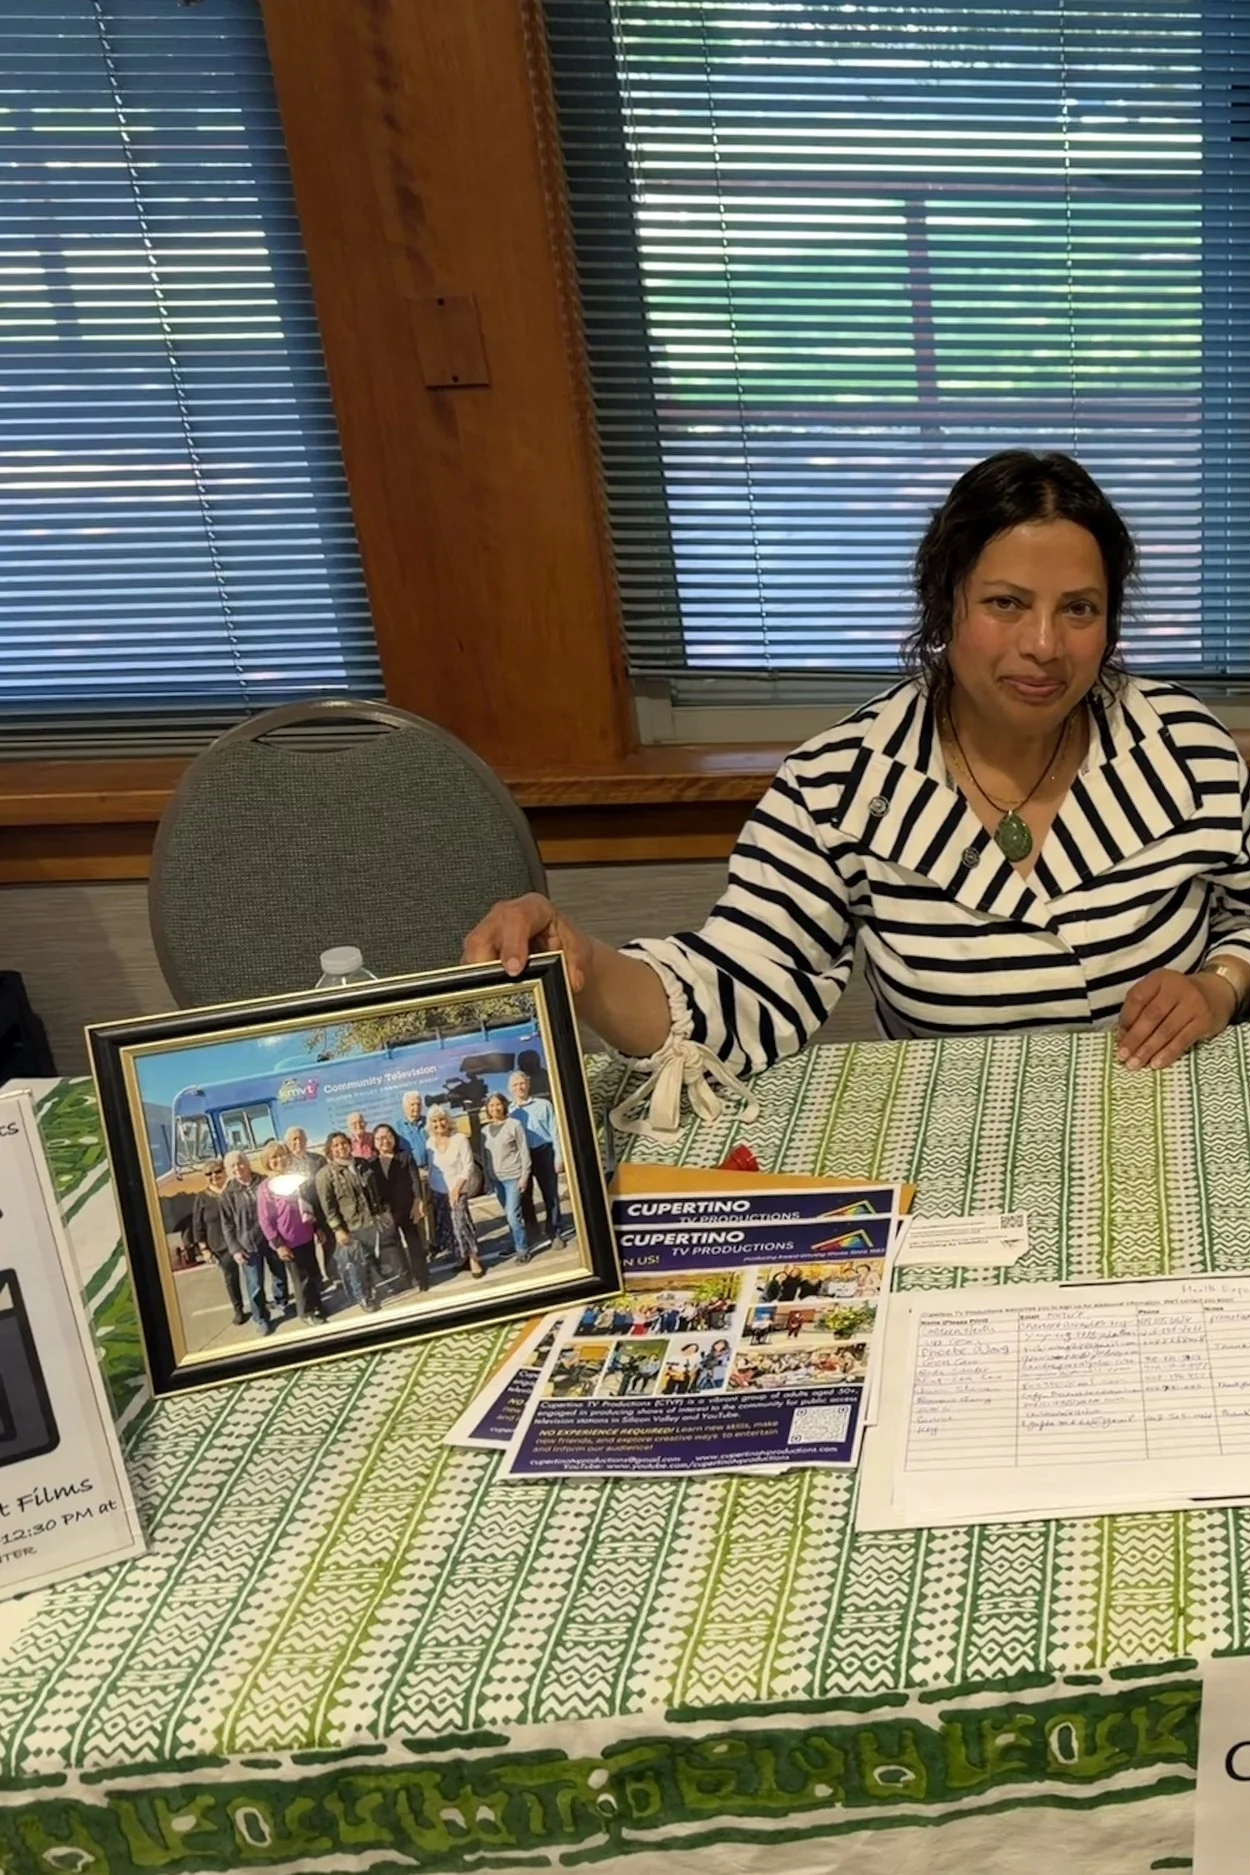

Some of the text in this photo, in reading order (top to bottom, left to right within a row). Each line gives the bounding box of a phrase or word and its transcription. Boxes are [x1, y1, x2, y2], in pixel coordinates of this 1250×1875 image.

[323, 1075, 383, 1094] Community
[383, 1064, 437, 1082] Television
[627, 1200, 751, 1217] CUPERTINO
[700, 1211, 800, 1222] PRODUCTIONS
[620, 1231, 745, 1247] CUPERTINO
[672, 1241, 795, 1256] TV PRODUCTIONS
[637, 1255, 660, 1265] US!
[557, 1427, 618, 1436] EXPERIENCE
[620, 1426, 673, 1435] REQUIRED!
[676, 1425, 703, 1433] Learn
[705, 1424, 726, 1432] new
[726, 1421, 752, 1430] skills,
[753, 1420, 779, 1428] make
[535, 1428, 779, 1445] new friends, and explore creative ways to entertain
[532, 1445, 552, 1453] and
[16, 1478, 94, 1512] Films
[1, 1500, 118, 1545] 12:30 PM at
